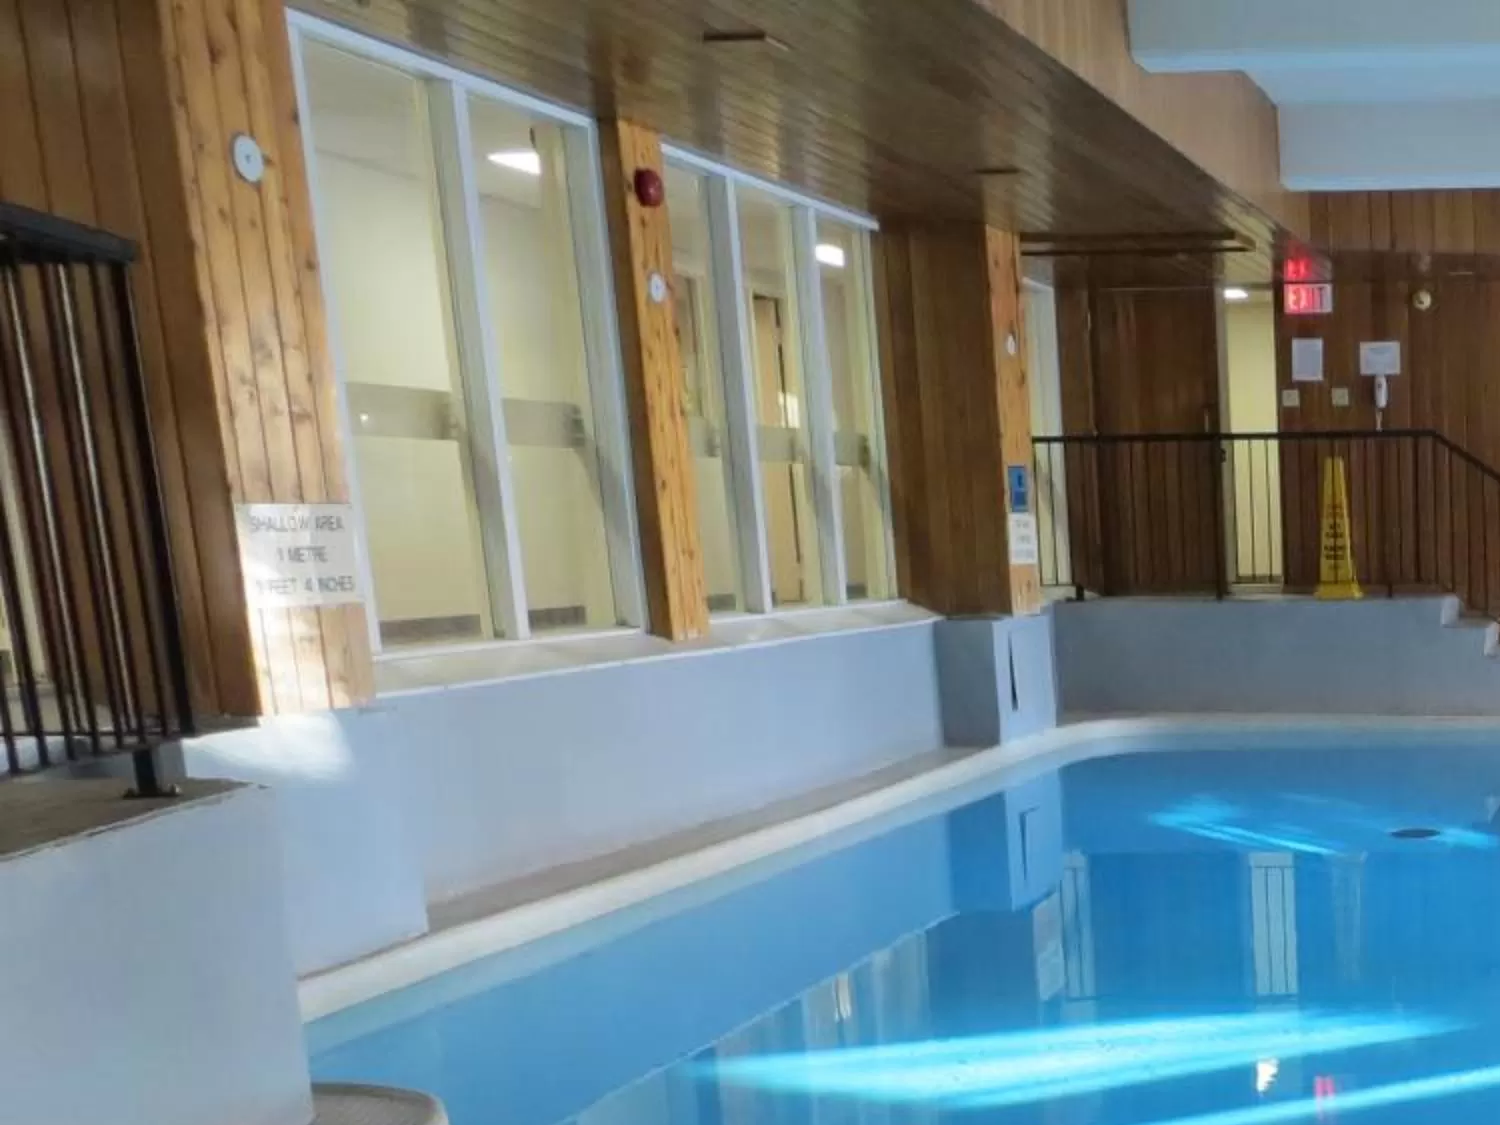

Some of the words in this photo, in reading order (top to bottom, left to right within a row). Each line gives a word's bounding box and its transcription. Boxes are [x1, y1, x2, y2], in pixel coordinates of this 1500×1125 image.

[1286, 286, 1326, 312] EXIT
[249, 514, 309, 533] SHALLOW
[314, 514, 345, 532] AREA
[287, 545, 328, 563] METRE
[316, 574, 356, 593] INCHES
